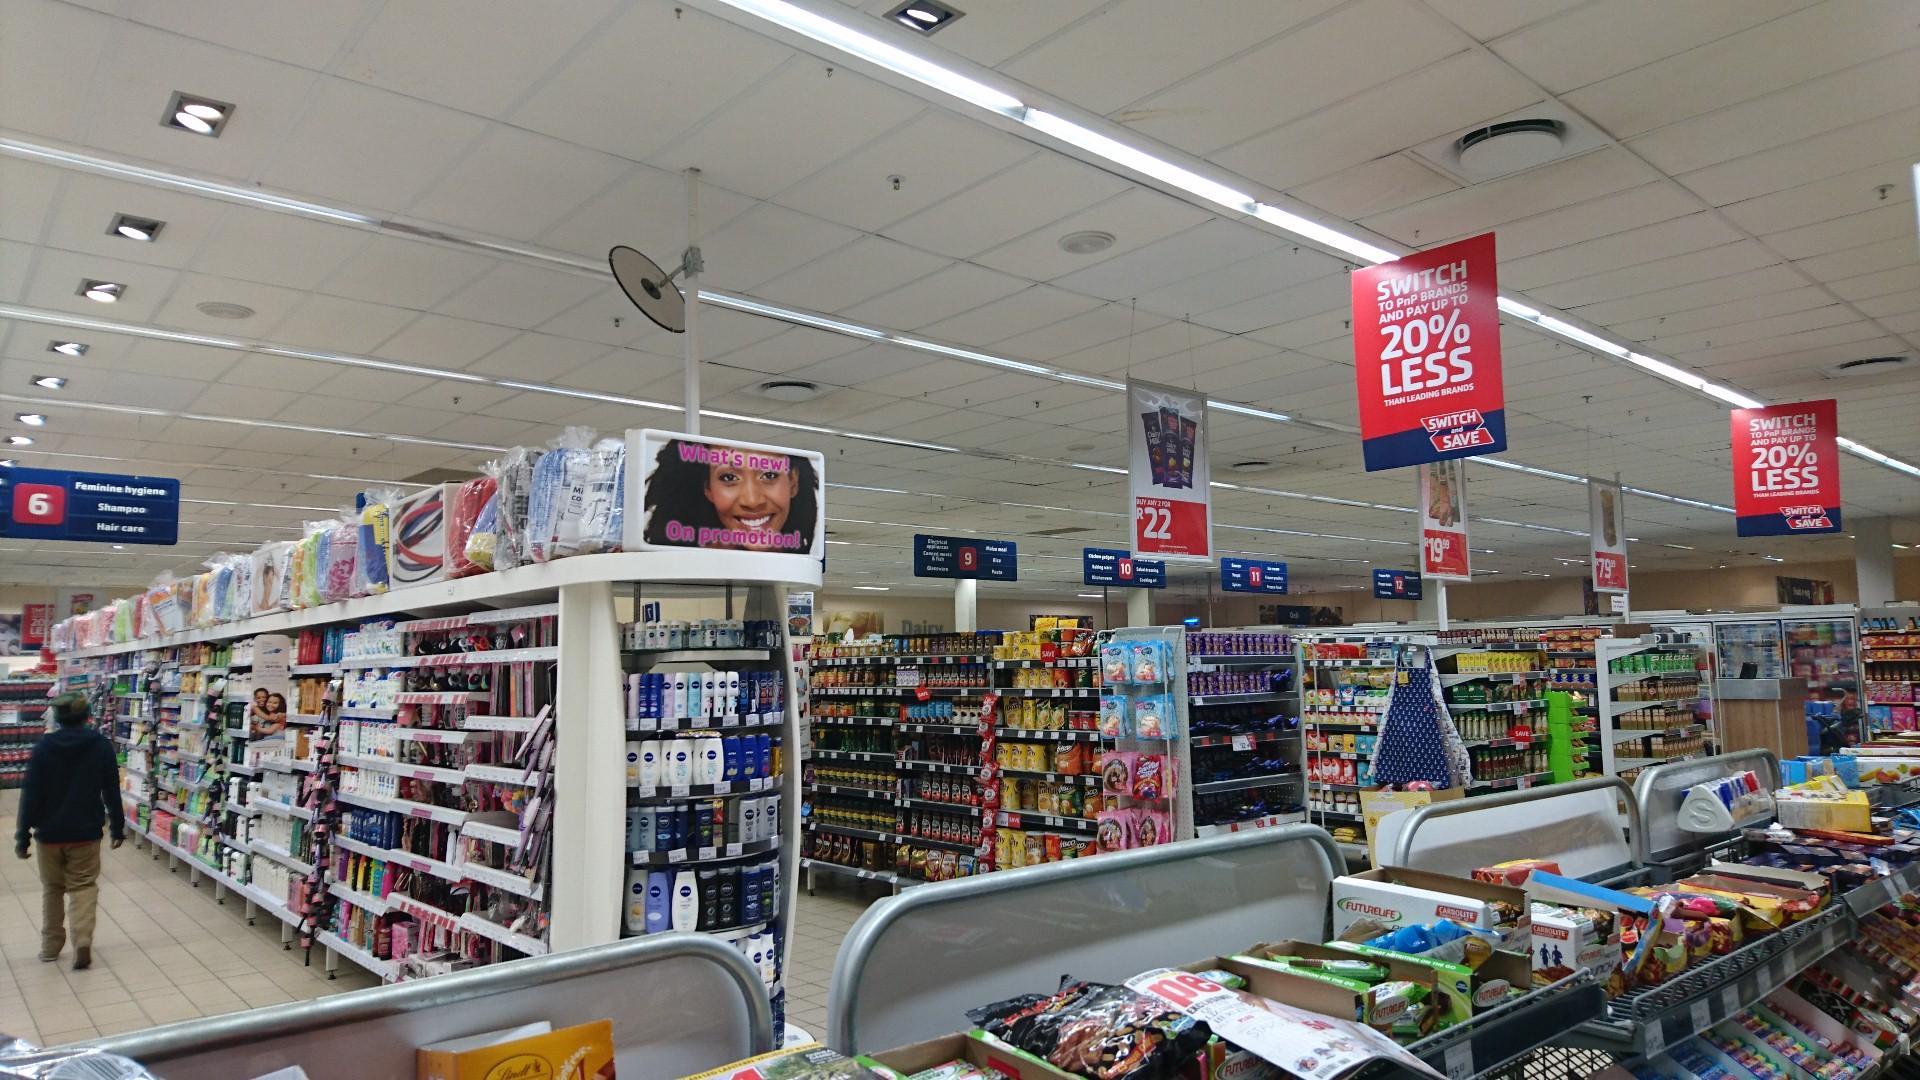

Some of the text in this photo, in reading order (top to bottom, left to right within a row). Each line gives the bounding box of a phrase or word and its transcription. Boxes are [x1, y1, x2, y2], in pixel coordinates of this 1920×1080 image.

[1376, 260, 1467, 302] SWITCH
[1378, 281, 1468, 312] TO PnP BRANDS
[1379, 294, 1468, 324] AND PAY UP TO
[1380, 308, 1470, 361] 20%
[1381, 346, 1472, 396] LESS
[1384, 383, 1474, 407] THAN LEADING BRANDS
[1428, 412, 1476, 431] SWITCH
[1750, 413, 1816, 431] SWITCH
[1451, 426, 1463, 434] and
[1781, 427, 1816, 436] BRANDS
[1442, 430, 1480, 449] SAVE
[1751, 438, 1769, 446] AND
[1772, 437, 1788, 445] PAY
[678, 443, 790, 472] What's new!
[1752, 443, 1817, 469] 20%
[1752, 466, 1818, 491] LESS
[75, 481, 166, 496] Feminine hygiene
[28, 493, 49, 515] 6
[98, 503, 146, 514] Shampoo
[1785, 507, 1821, 515] SWITCH
[97, 522, 144, 533] Hair care
[1796, 519, 1822, 527] SAVE
[666, 520, 800, 547] On promotion!
[965, 553, 972, 565] 9
[1121, 563, 1131, 575] 10
[1252, 572, 1259, 582] 11
[1396, 580, 1403, 589] 12
[902, 619, 945, 634] Dairy
[1042, 650, 1055, 658] SAVE
[1346, 901, 1396, 919] FUTURELIFE
[1438, 906, 1474, 919] CARBOLITE
[1533, 925, 1566, 937] CARBOLITE
[1375, 1001, 1406, 1018] FUTURELIFE
